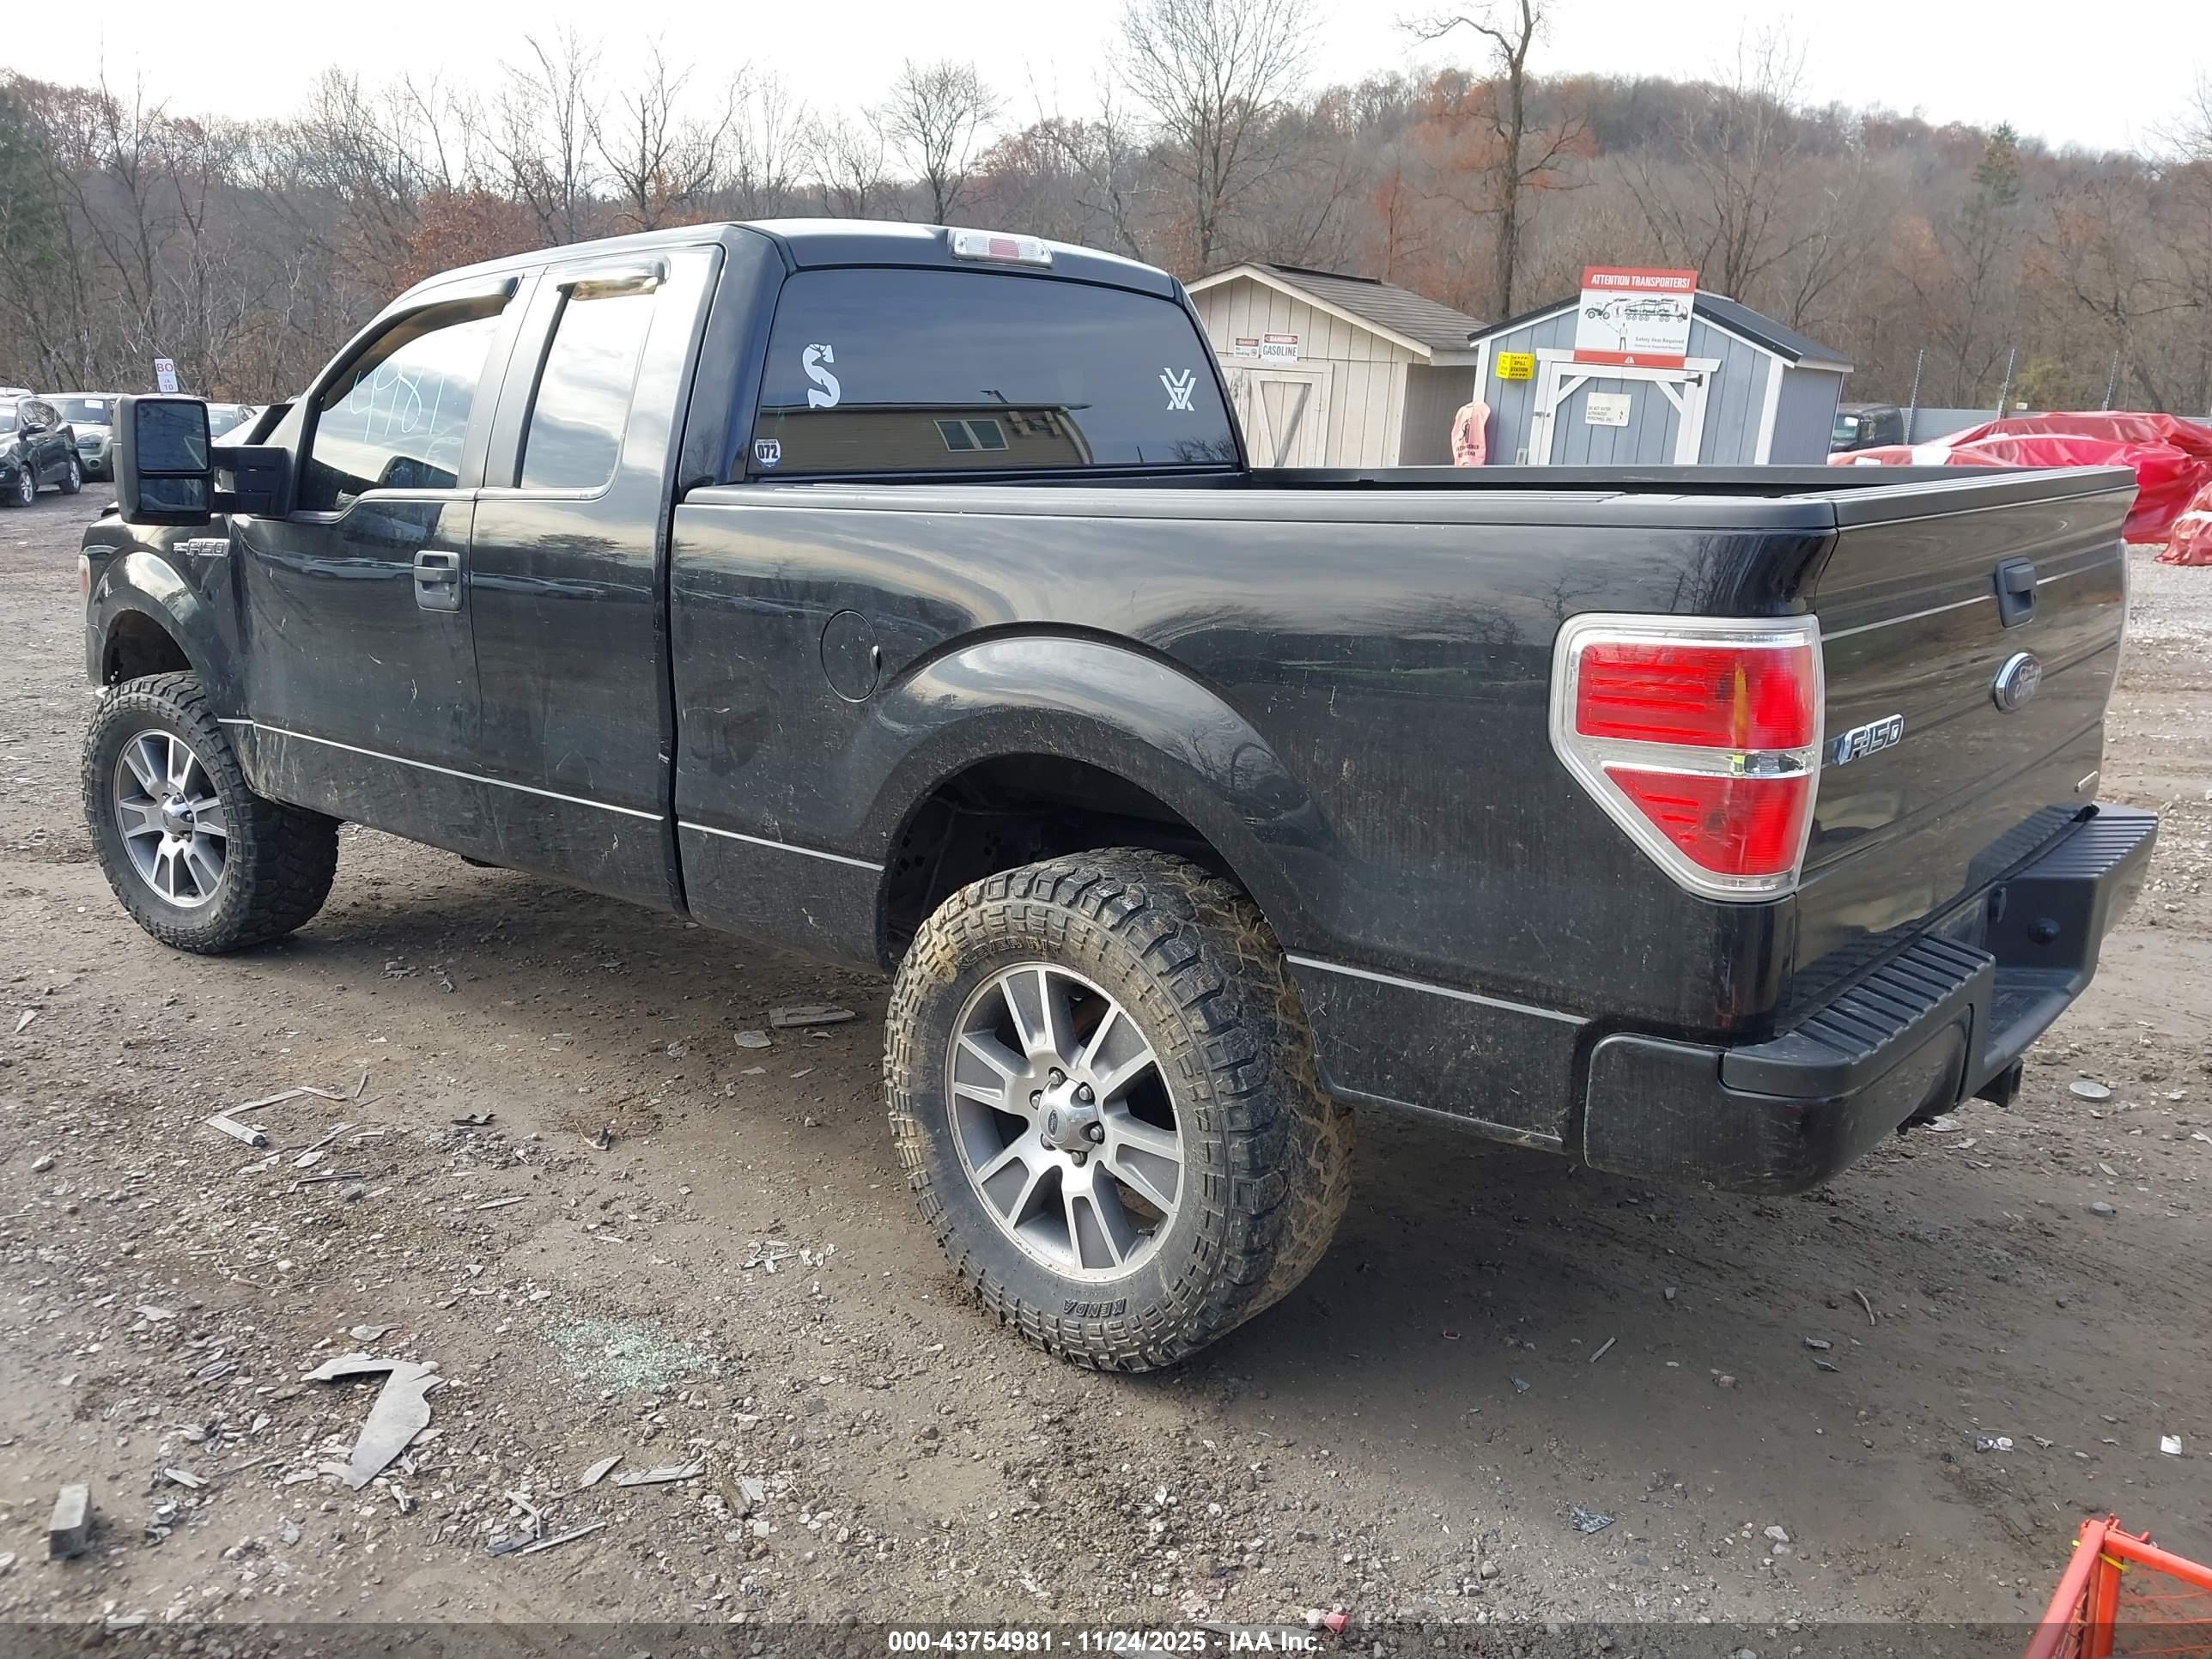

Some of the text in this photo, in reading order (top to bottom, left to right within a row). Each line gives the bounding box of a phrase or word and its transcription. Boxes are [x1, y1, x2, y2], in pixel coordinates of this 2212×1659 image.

[1591, 274, 1691, 289] ATTENTION TRANSPORTERS!
[1262, 344, 1297, 357] GASOLINE
[757, 444, 779, 459] 072
[1063, 1297, 1127, 1318] KENDA
